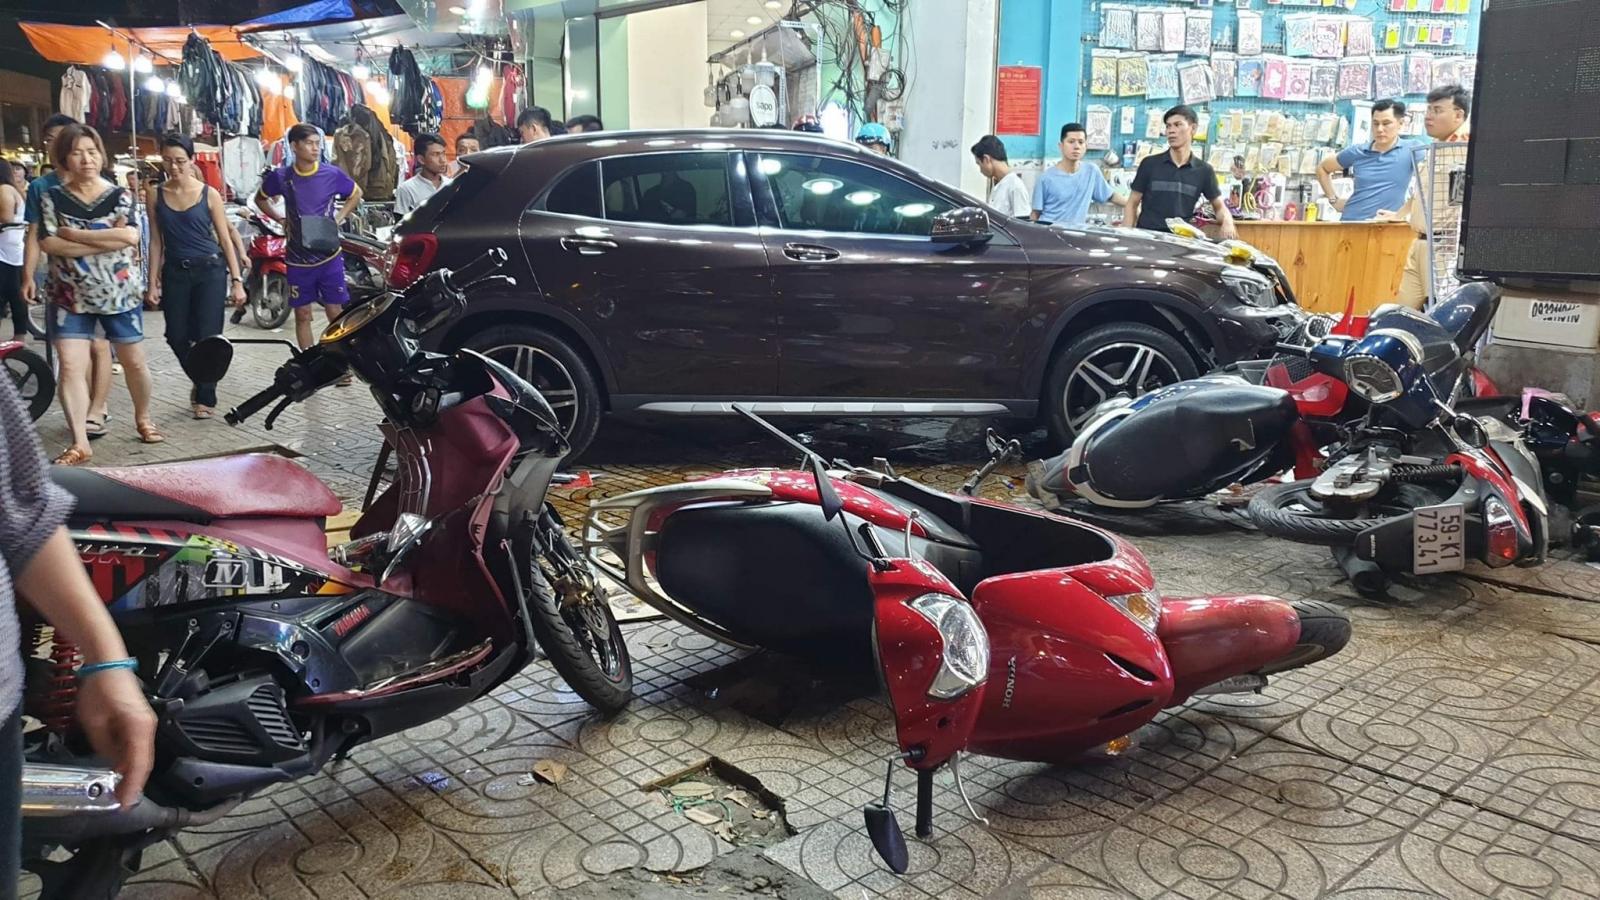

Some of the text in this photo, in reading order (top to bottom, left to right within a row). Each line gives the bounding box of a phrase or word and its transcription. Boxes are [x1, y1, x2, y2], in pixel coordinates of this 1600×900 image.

[1417, 511, 1438, 567] 773.41
[335, 604, 370, 637] YAMAHA
[1002, 655, 1016, 708] HONDA
